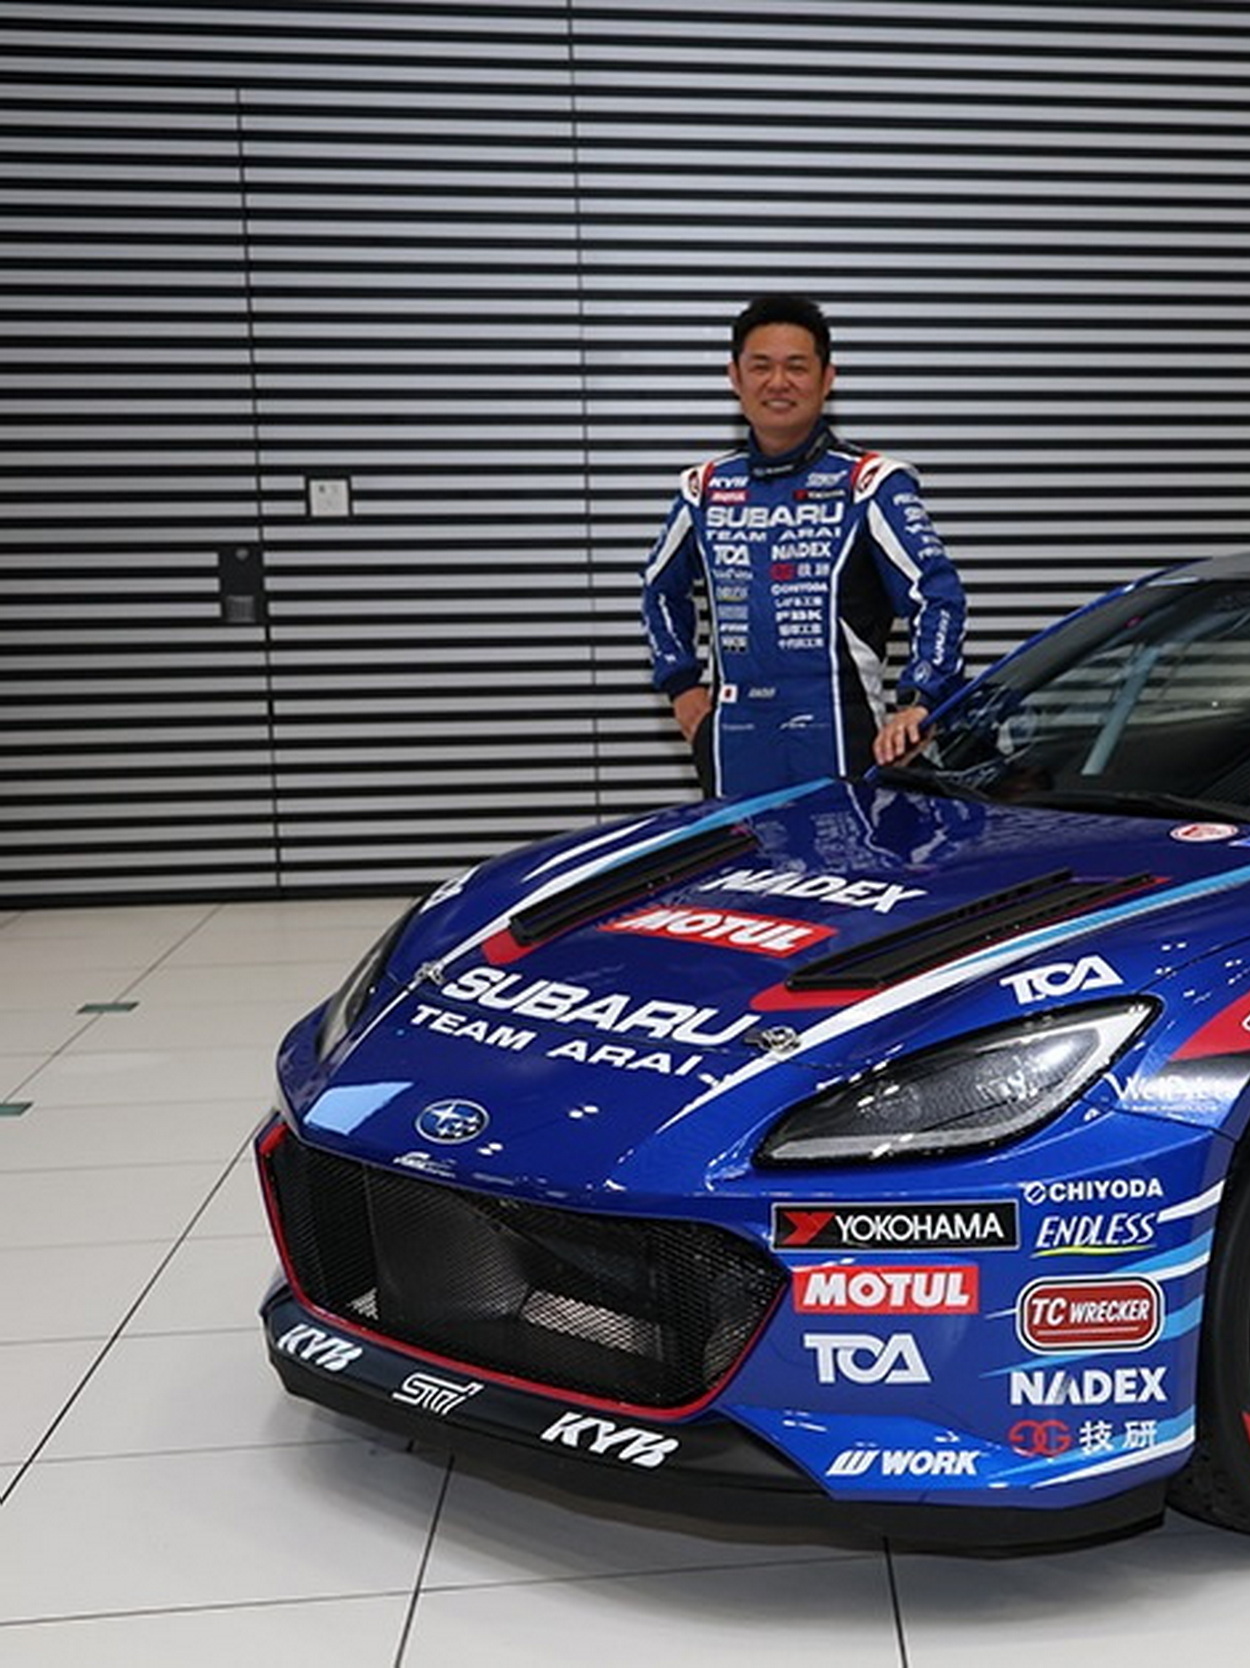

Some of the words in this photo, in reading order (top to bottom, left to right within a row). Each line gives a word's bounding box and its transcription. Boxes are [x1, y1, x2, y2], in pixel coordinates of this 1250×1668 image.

[706, 502, 844, 528] SUBARU
[706, 529, 767, 542] TEAM
[778, 527, 841, 542] ARAI
[771, 542, 831, 561] NADEX
[702, 868, 926, 913] NADEX
[617, 909, 816, 950] MOTUL
[1000, 956, 1123, 1004] TOA
[441, 966, 761, 1046] SUBARU
[410, 1005, 534, 1051] TEAM
[547, 1043, 704, 1076] ARAI
[1049, 1178, 1163, 1202] CHIYODA
[835, 1212, 1004, 1242] YOKOHAMA
[1036, 1212, 1157, 1248] ENDLESS
[803, 1272, 970, 1308] MOTUL
[1030, 1296, 1066, 1325] TC
[1068, 1293, 1150, 1323] WRECKER
[277, 1322, 363, 1372] KYB
[804, 1333, 931, 1384] TOA
[1010, 1366, 1167, 1405] NADEX
[541, 1411, 680, 1468] KYB
[1079, 1419, 1158, 1453] 技研
[880, 1450, 982, 1475] WORK
